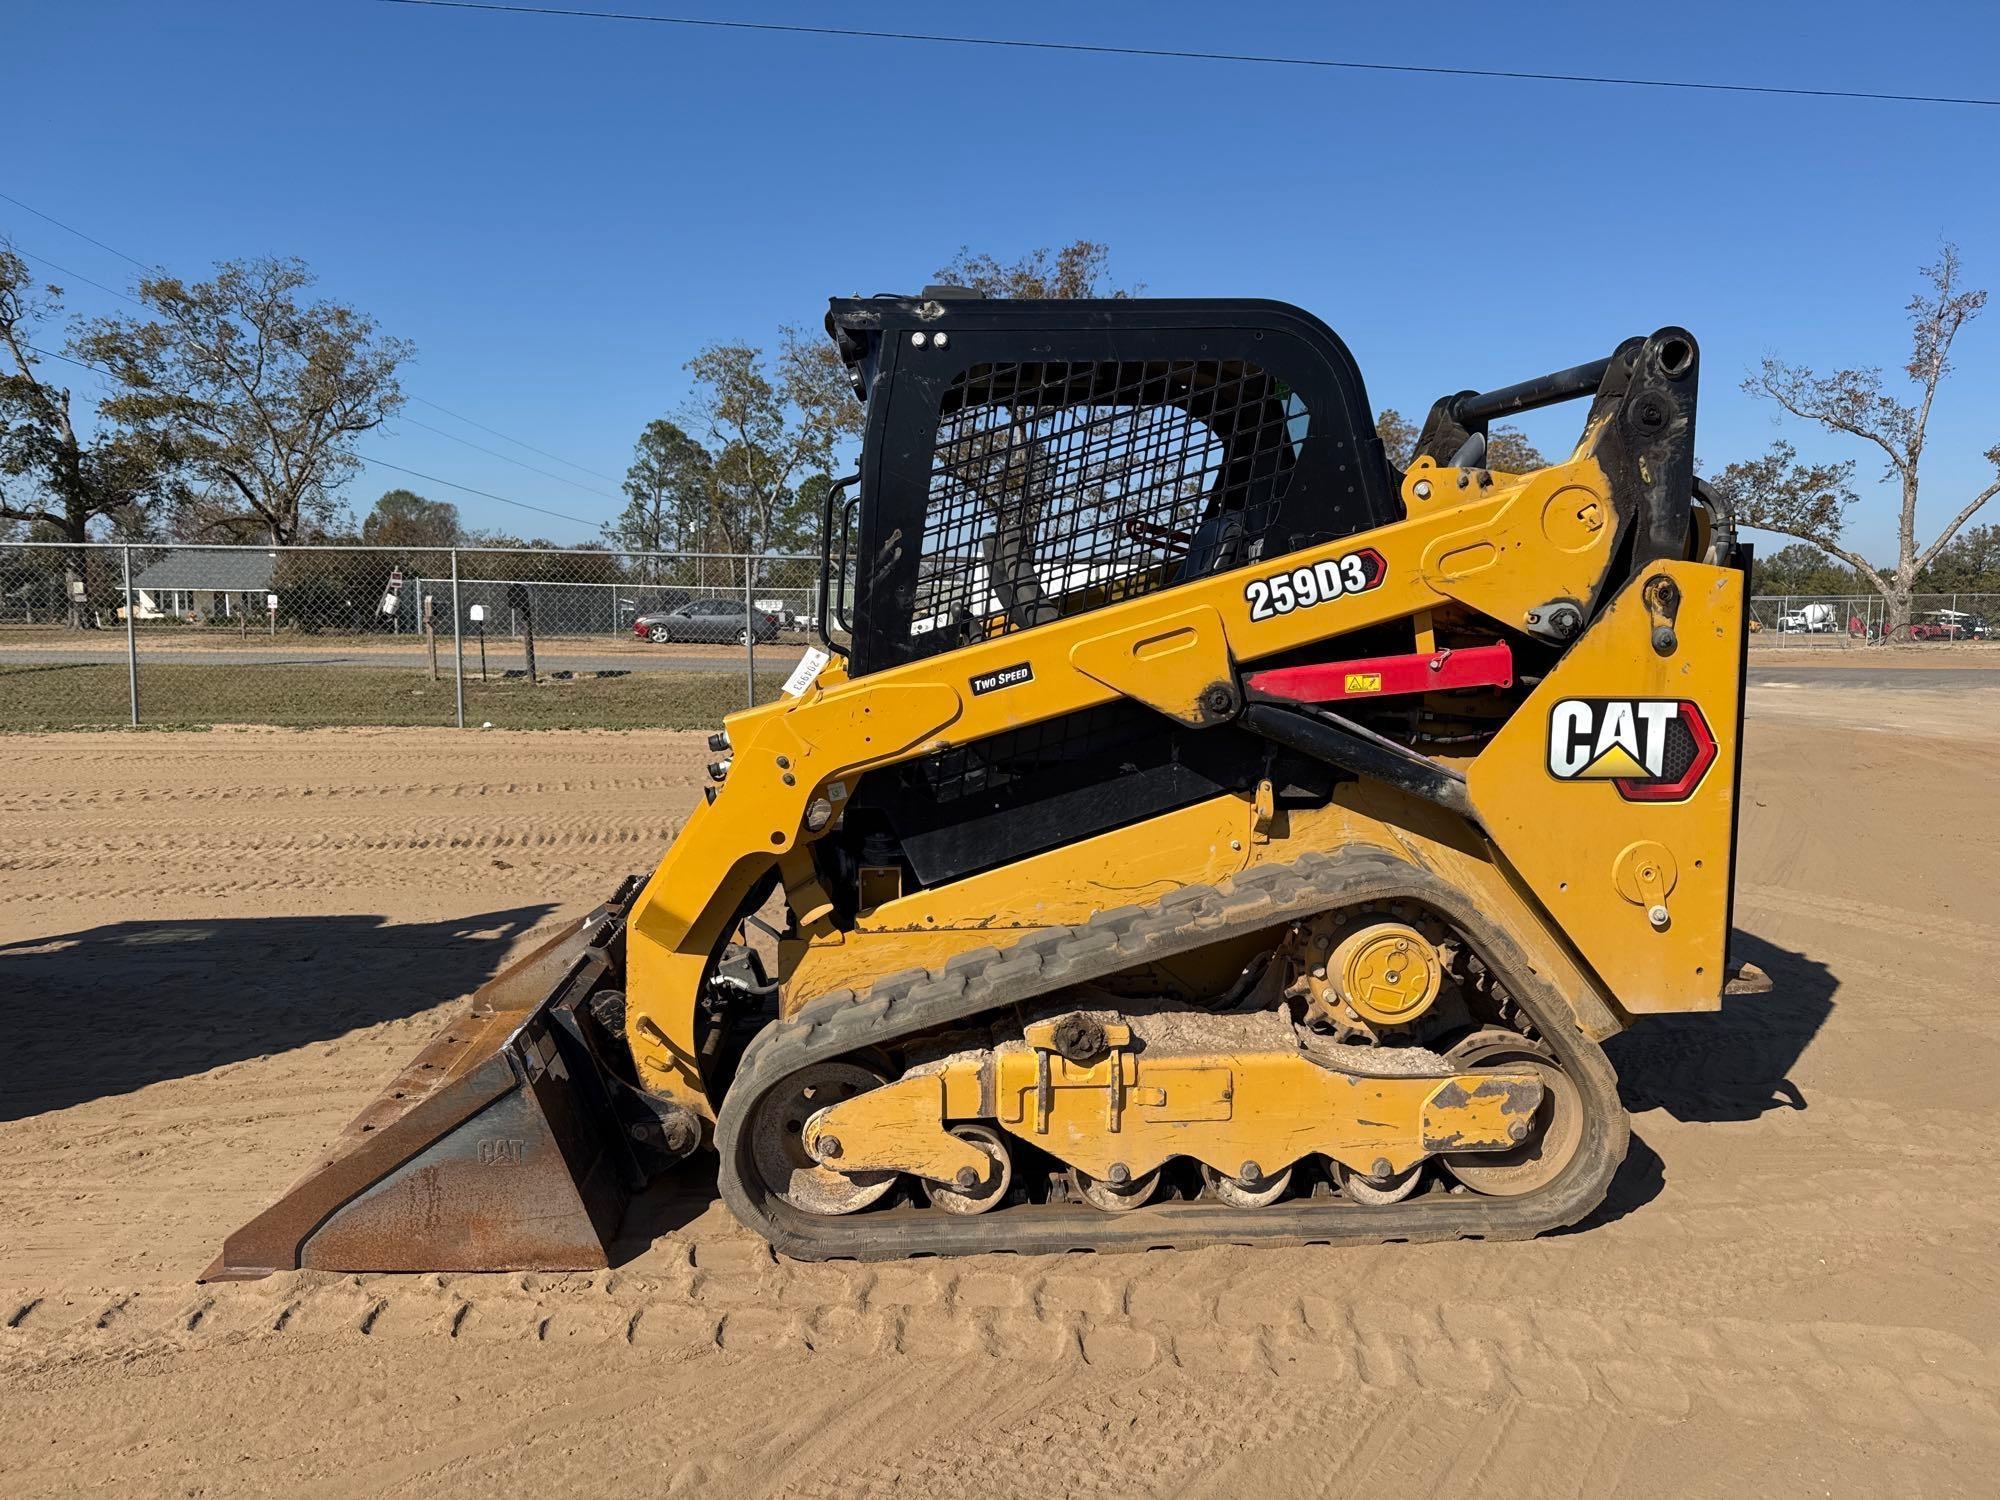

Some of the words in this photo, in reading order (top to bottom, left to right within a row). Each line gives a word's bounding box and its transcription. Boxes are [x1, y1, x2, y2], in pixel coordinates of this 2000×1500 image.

[1246, 554, 1367, 620] 259D3
[793, 660, 820, 691] 204993
[974, 677, 996, 691] TWO
[998, 668, 1028, 685] SPEED
[1549, 700, 1679, 778] CAT
[477, 1139, 526, 1167] CAT
